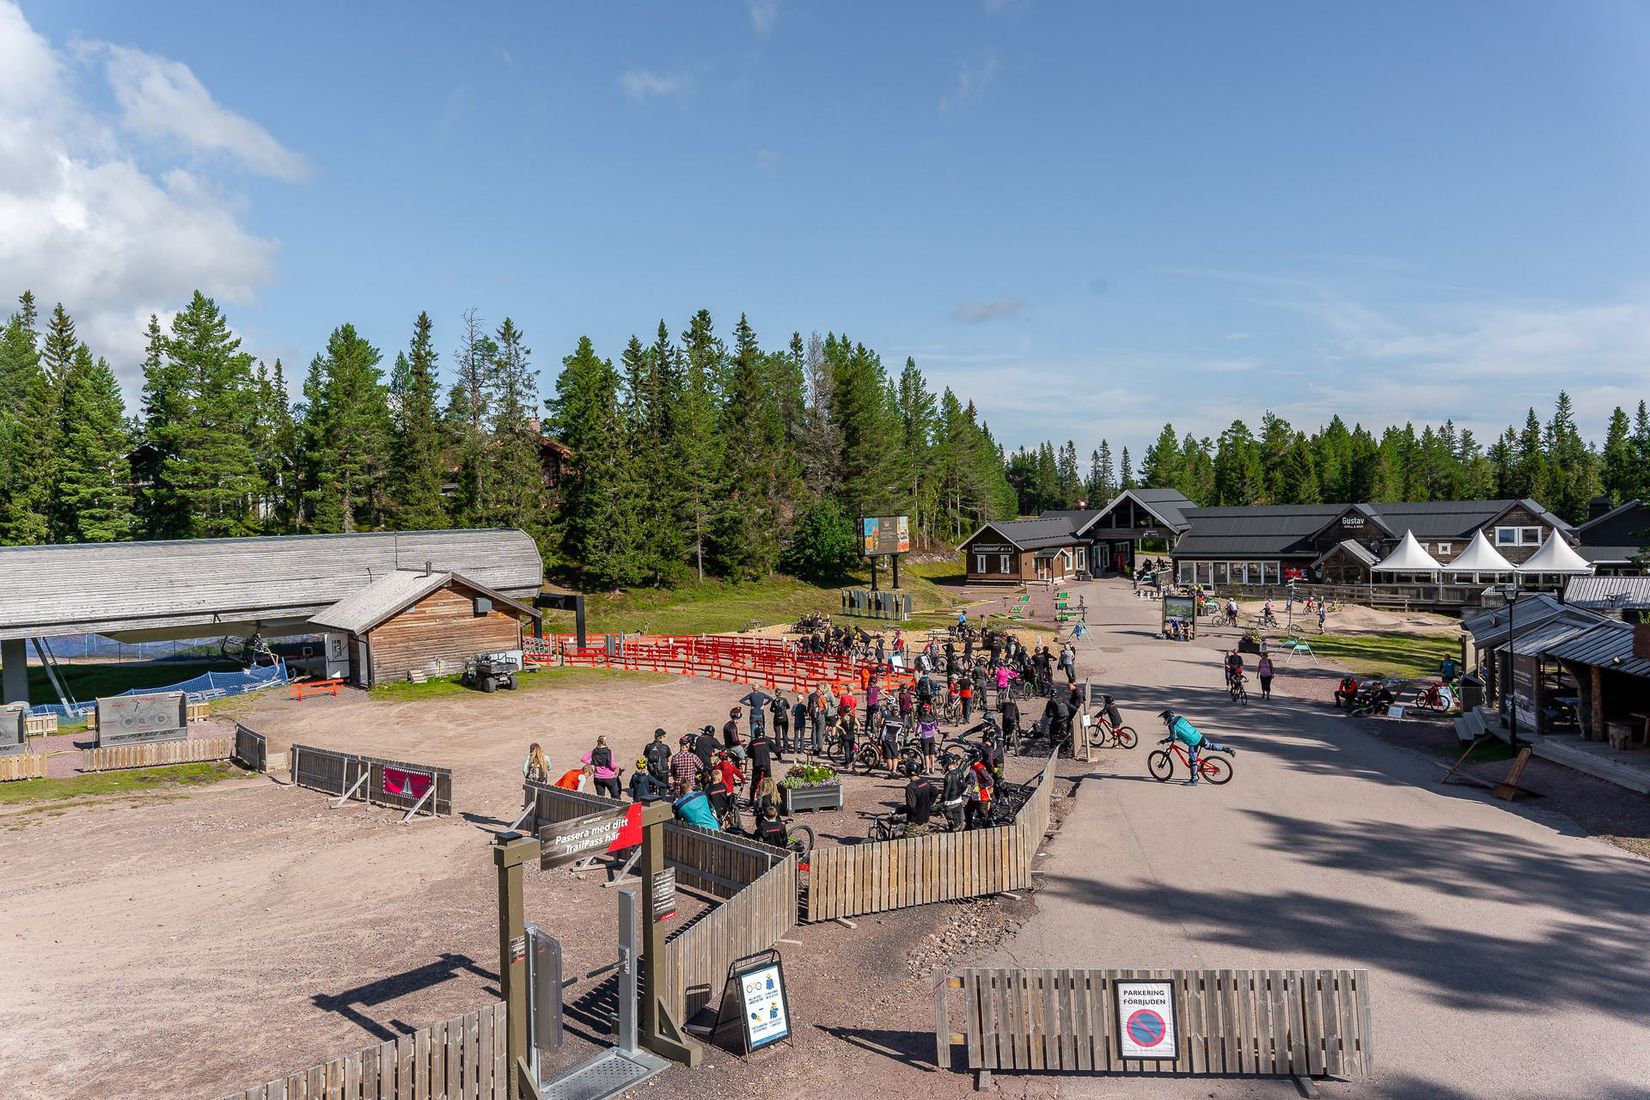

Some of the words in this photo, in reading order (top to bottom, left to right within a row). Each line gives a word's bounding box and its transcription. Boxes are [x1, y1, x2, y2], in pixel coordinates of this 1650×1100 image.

[1342, 516, 1365, 525] Gustav
[555, 829, 590, 846] Passera
[591, 821, 611, 836] med
[612, 817, 629, 829] ditt
[565, 836, 605, 854] TrailPass
[605, 831, 620, 842] här
[1123, 998, 1166, 1006] FÖRBJUDEN
